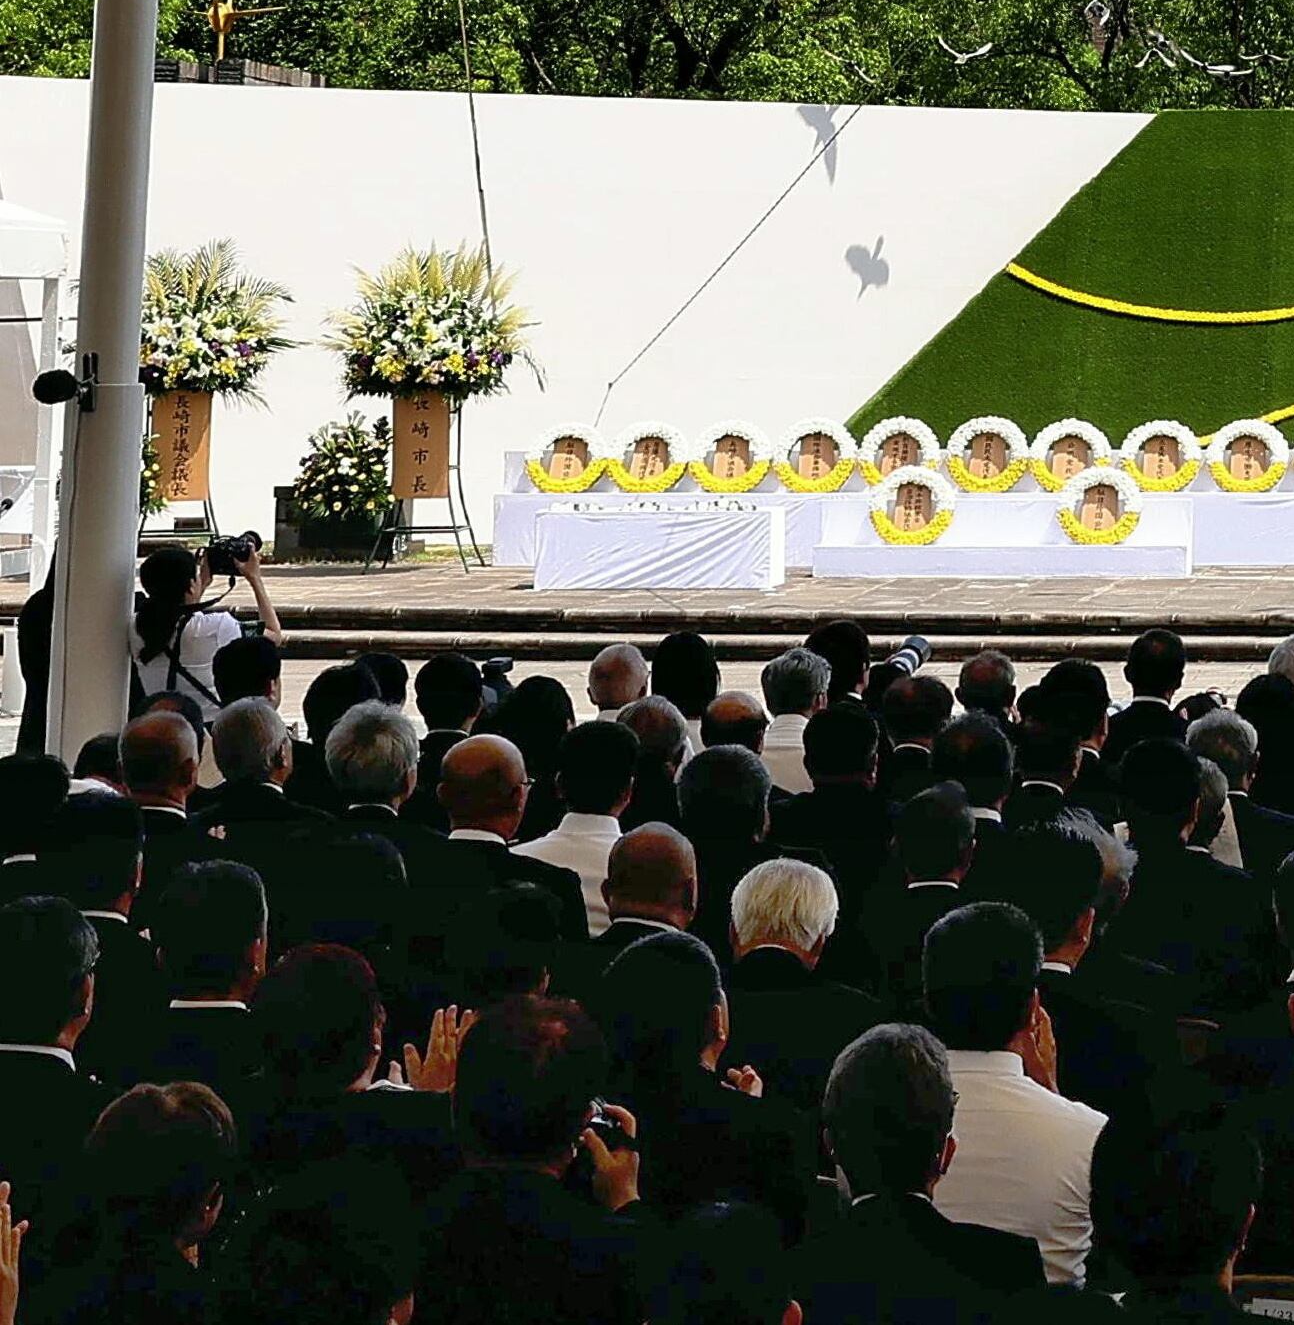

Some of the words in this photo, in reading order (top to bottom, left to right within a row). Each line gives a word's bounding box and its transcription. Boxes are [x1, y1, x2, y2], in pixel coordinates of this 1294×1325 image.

[171, 395, 191, 496] 長崎市議会議長
